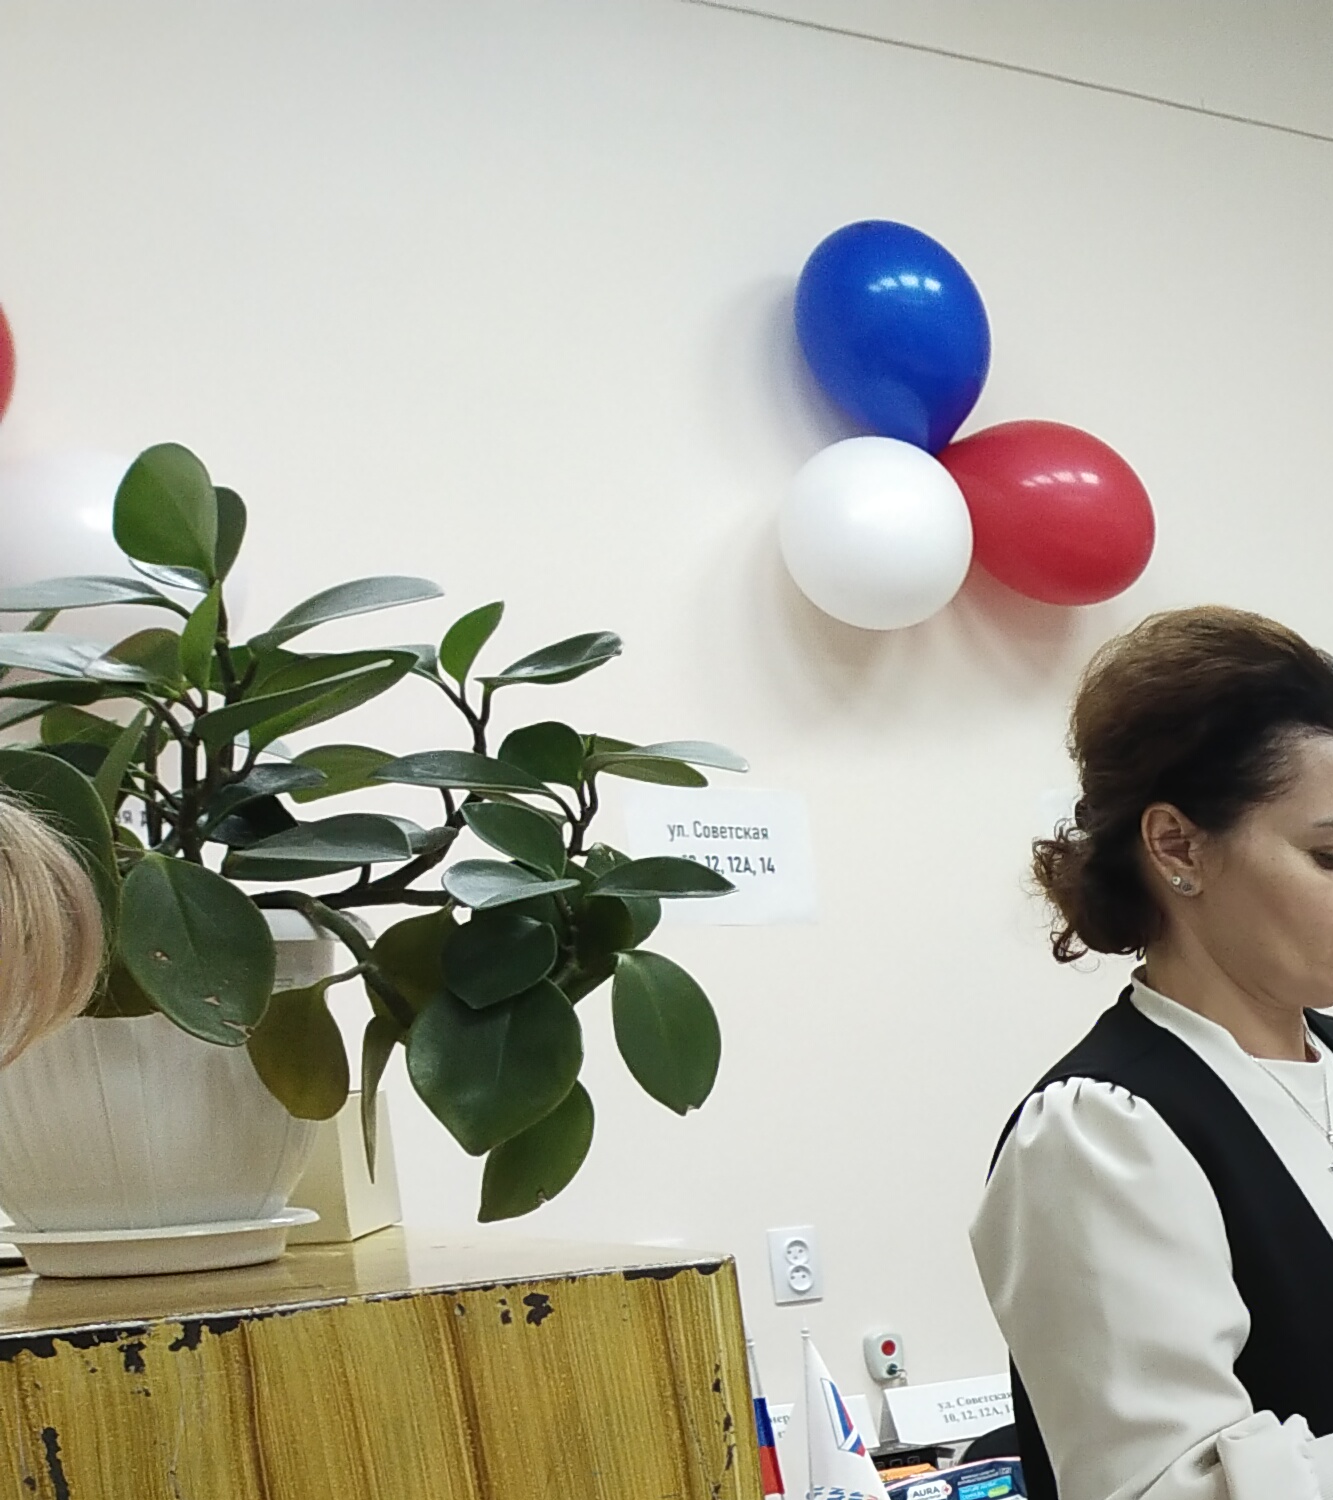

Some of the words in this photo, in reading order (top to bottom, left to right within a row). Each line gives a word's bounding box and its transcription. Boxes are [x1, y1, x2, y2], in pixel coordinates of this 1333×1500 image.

[667, 824, 689, 842] ул.
[693, 820, 769, 840] Советская
[727, 856, 757, 877] 12А,
[759, 857, 775, 874] 14
[912, 1486, 940, 1499] AURA
